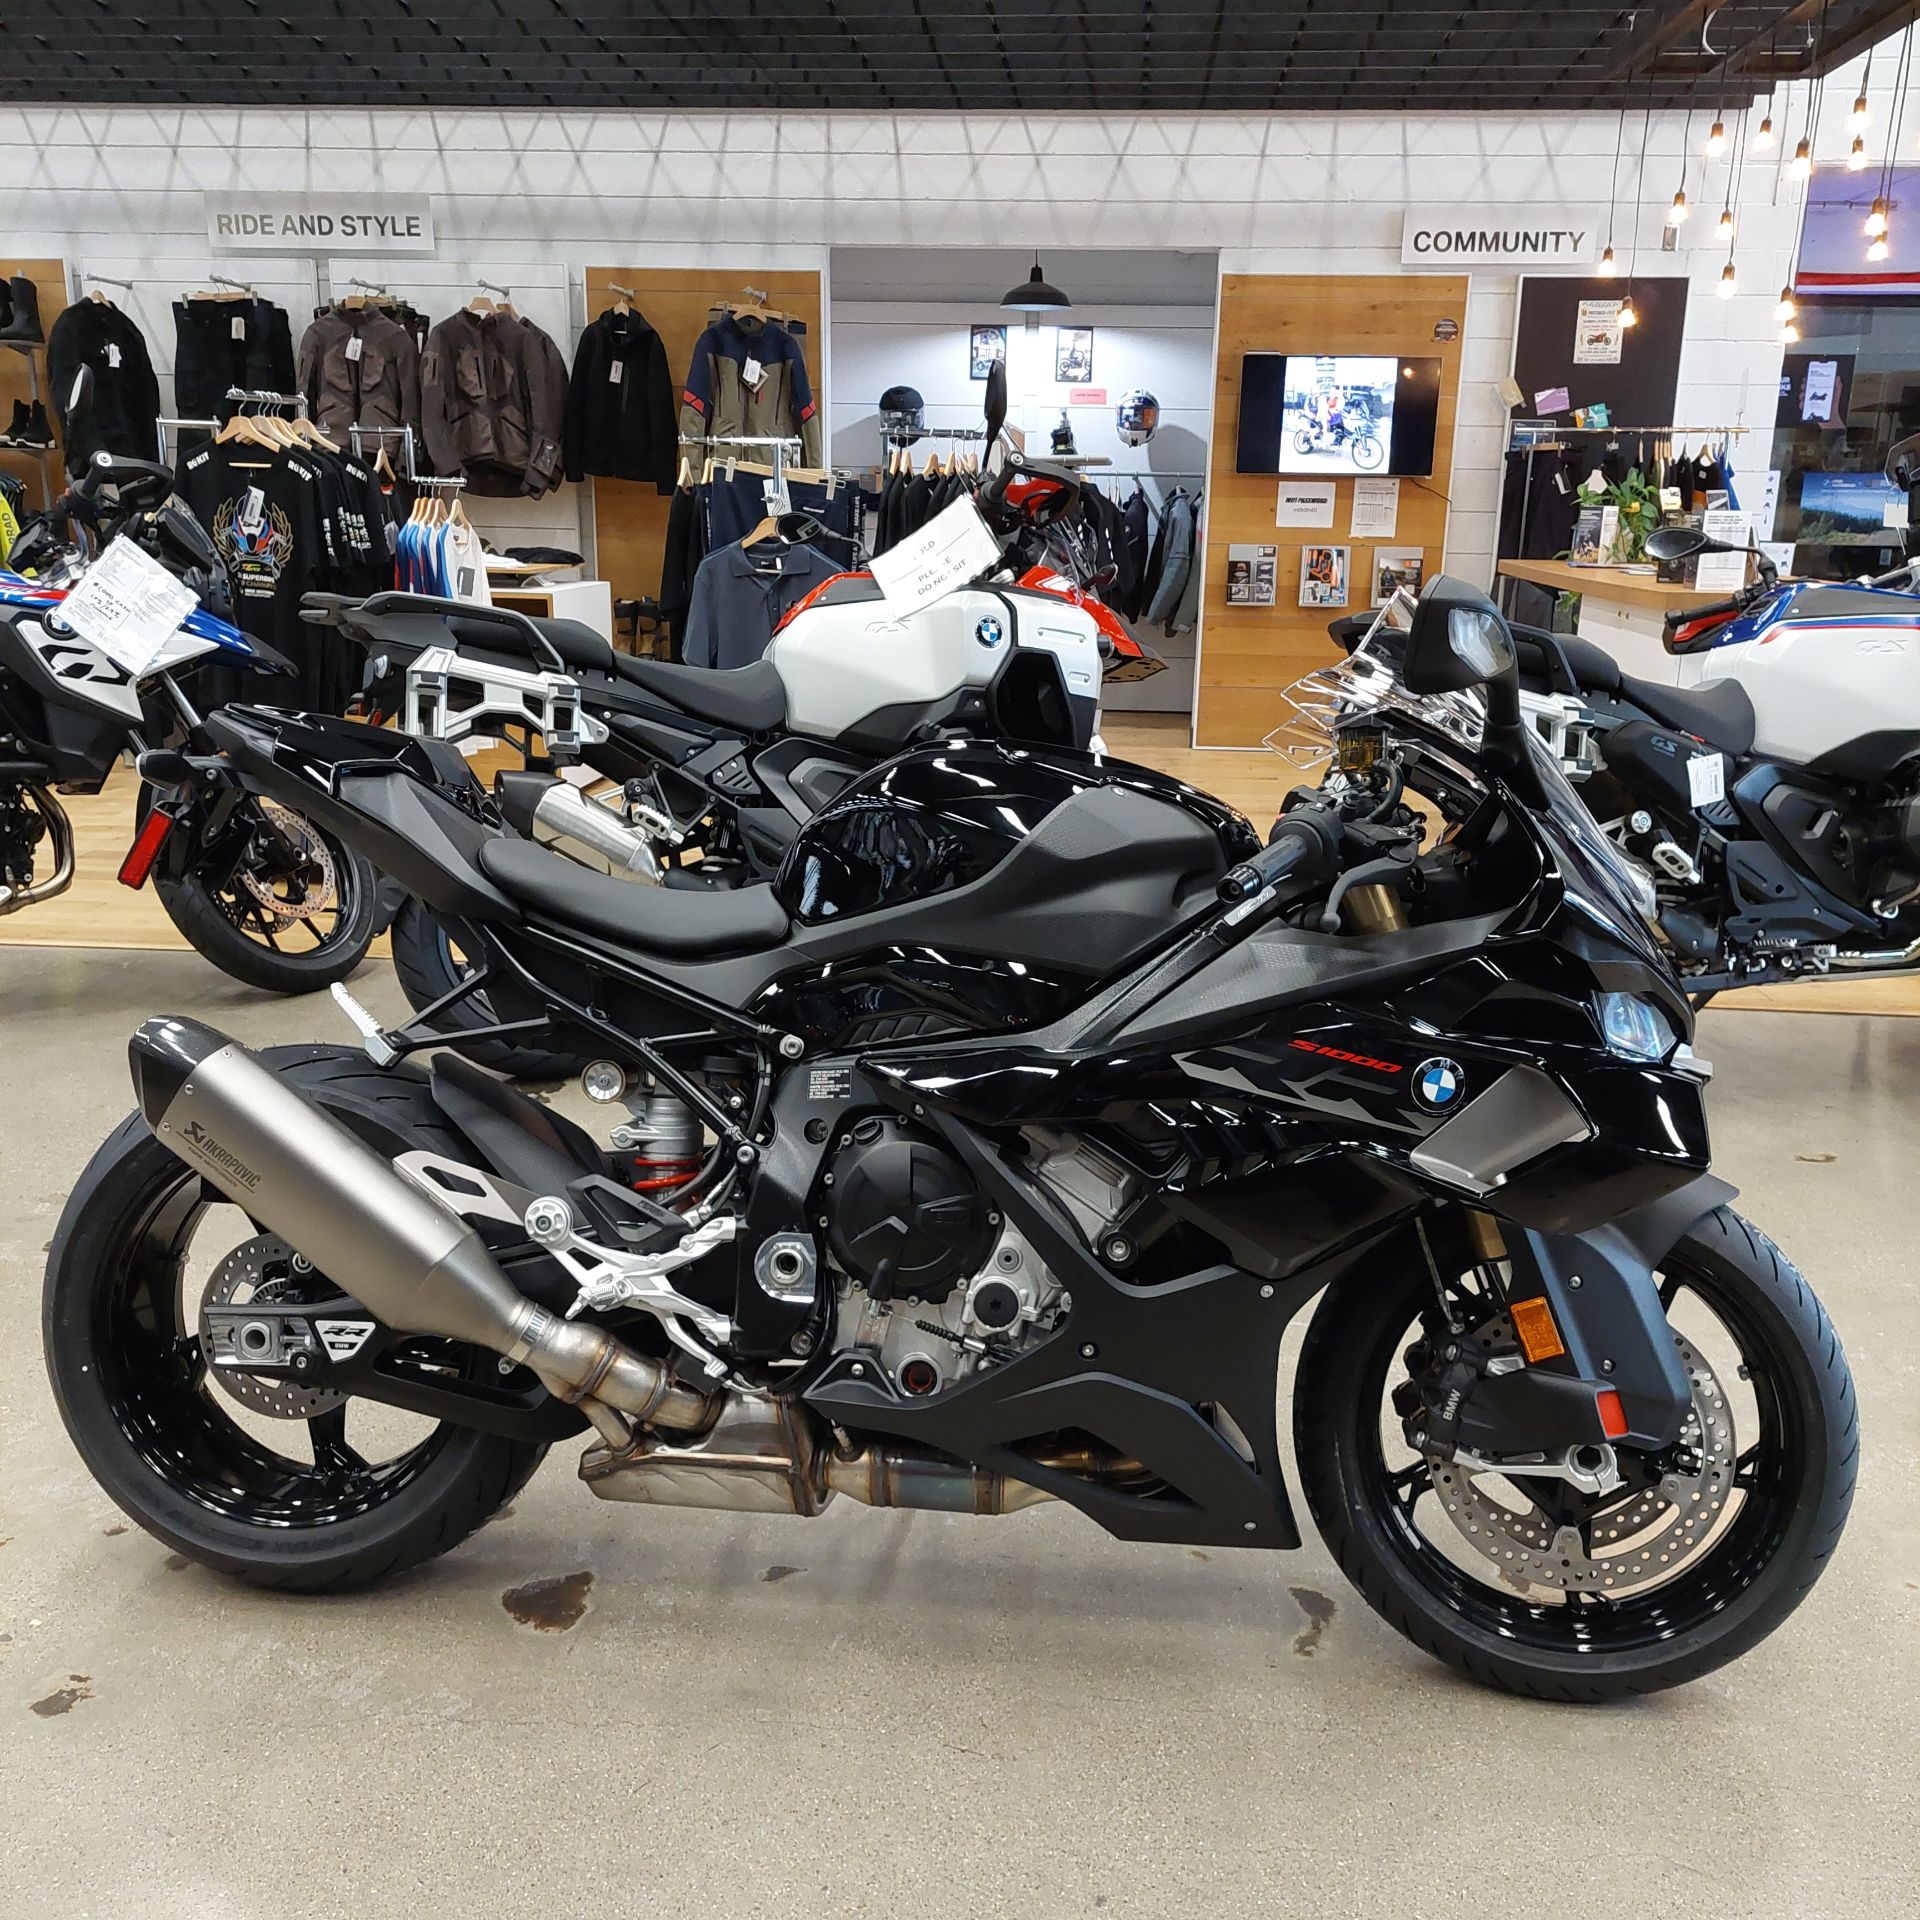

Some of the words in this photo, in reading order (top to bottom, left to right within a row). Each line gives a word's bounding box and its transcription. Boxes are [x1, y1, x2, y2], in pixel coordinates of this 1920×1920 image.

[216, 213, 276, 236] RIDE
[281, 214, 334, 237] AND
[340, 215, 422, 237] STYLE
[1413, 230, 1586, 254] COMMUNITY
[917, 555, 952, 583] PLEE
[917, 582, 933, 596] DO
[952, 558, 967, 573] SIT
[1287, 1038, 1404, 1074] S1000
[1442, 1388, 1462, 1422] BMW
